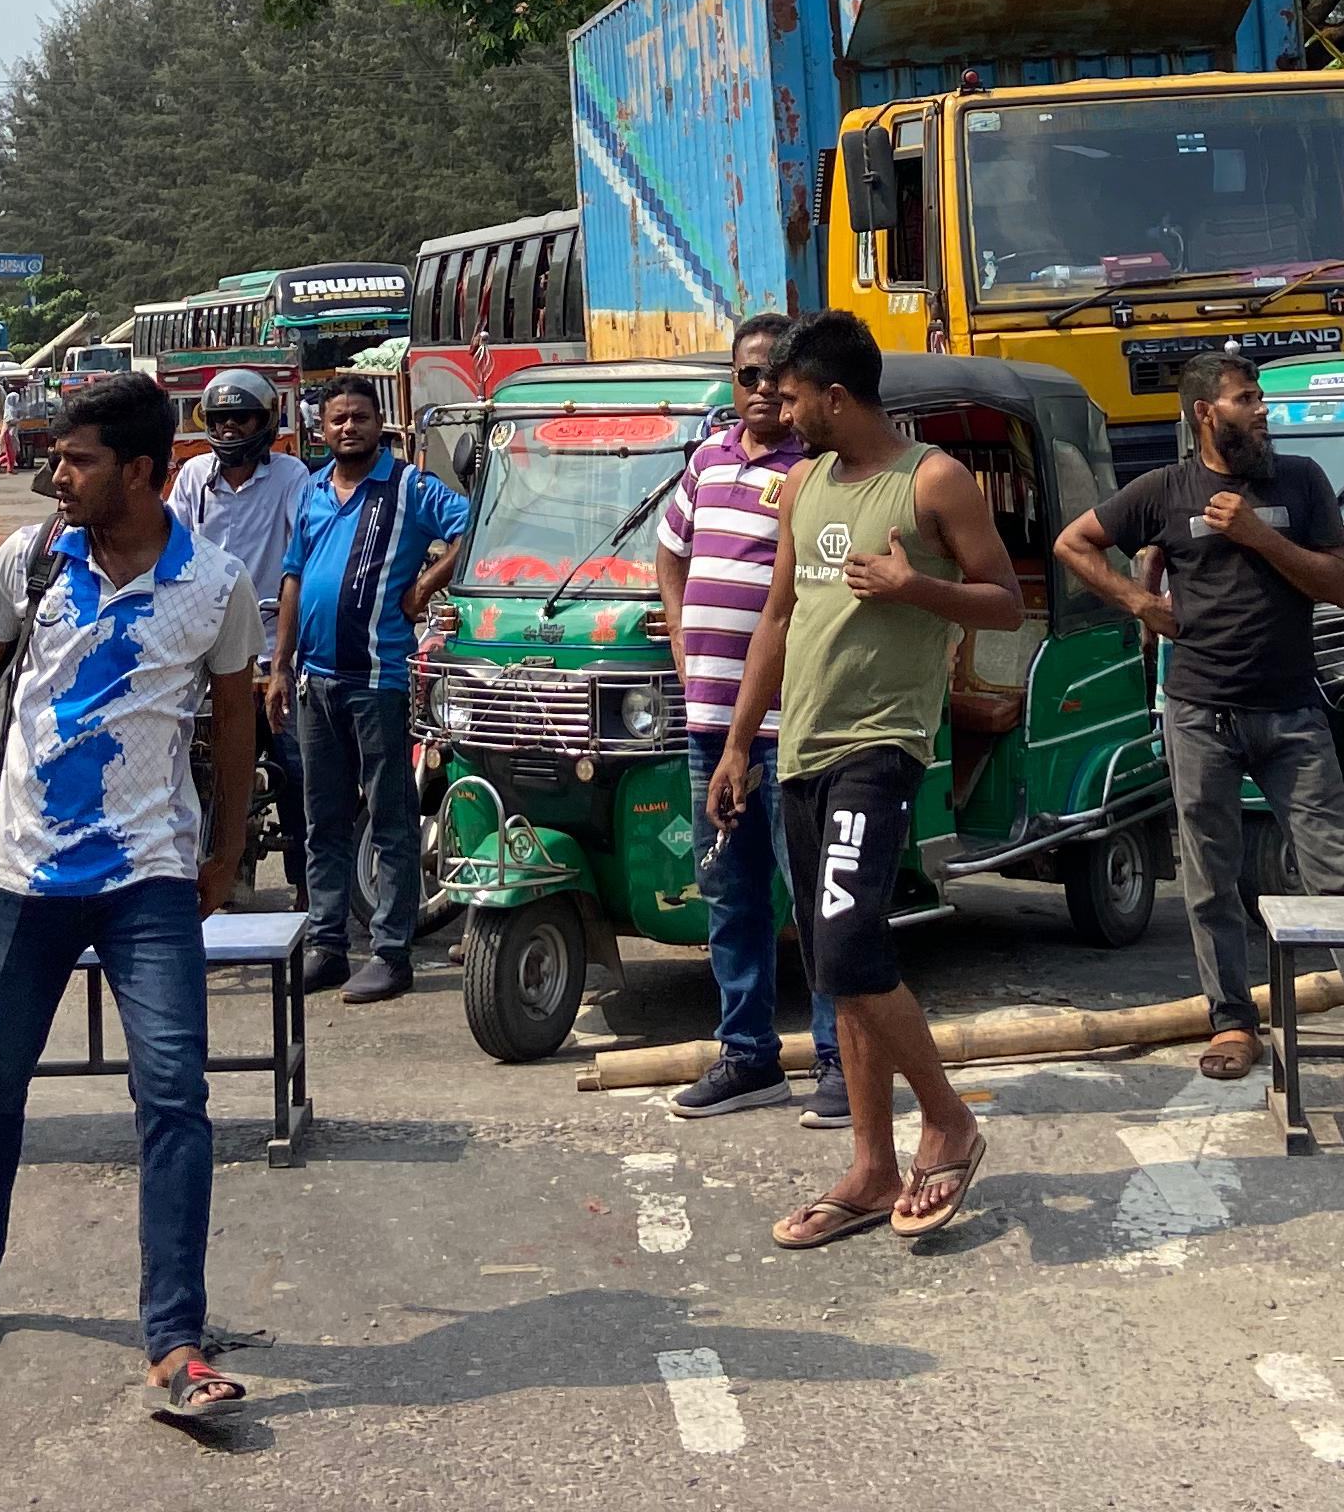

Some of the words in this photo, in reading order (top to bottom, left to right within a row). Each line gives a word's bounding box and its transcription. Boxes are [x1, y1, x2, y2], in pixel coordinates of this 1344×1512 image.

[1126, 337, 1217, 356] ASHOK
[1227, 328, 1341, 348] LEYLAND
[795, 564, 840, 581] PHILIPP
[666, 831, 693, 843] LPG
[822, 810, 867, 919] FILA
